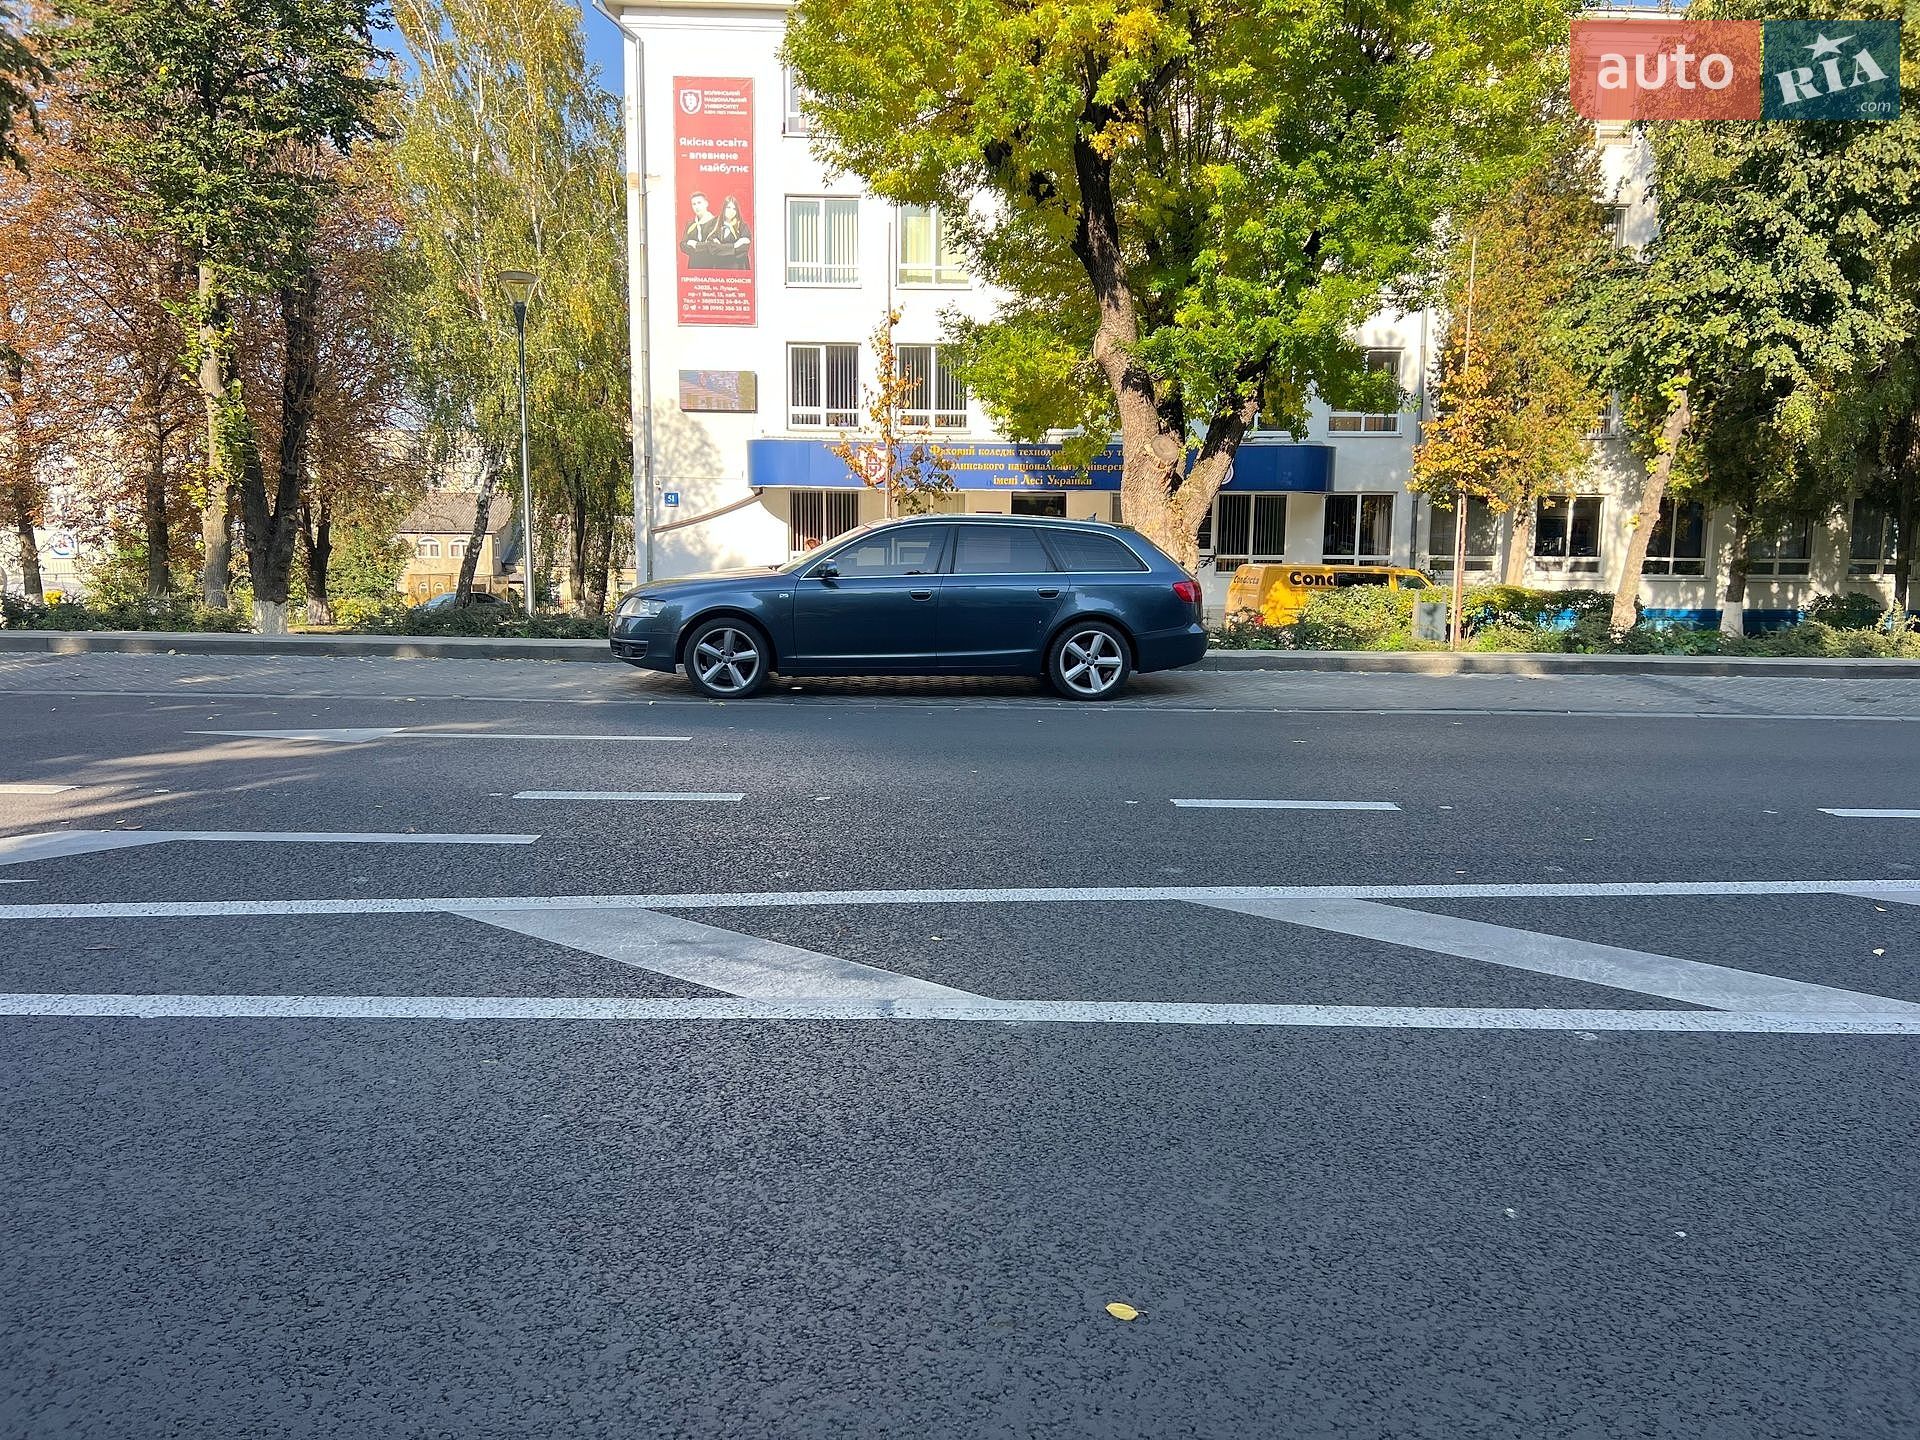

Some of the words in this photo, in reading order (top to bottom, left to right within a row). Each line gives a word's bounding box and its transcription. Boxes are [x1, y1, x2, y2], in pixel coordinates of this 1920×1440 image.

[679, 137, 713, 147] Якісна
[716, 138, 749, 148] освіта
[689, 152, 739, 161] впевнене
[700, 163, 749, 174] майбутнє
[979, 448, 1015, 457] коледж
[993, 475, 1018, 485] імені
[1021, 474, 1043, 485] Лесі
